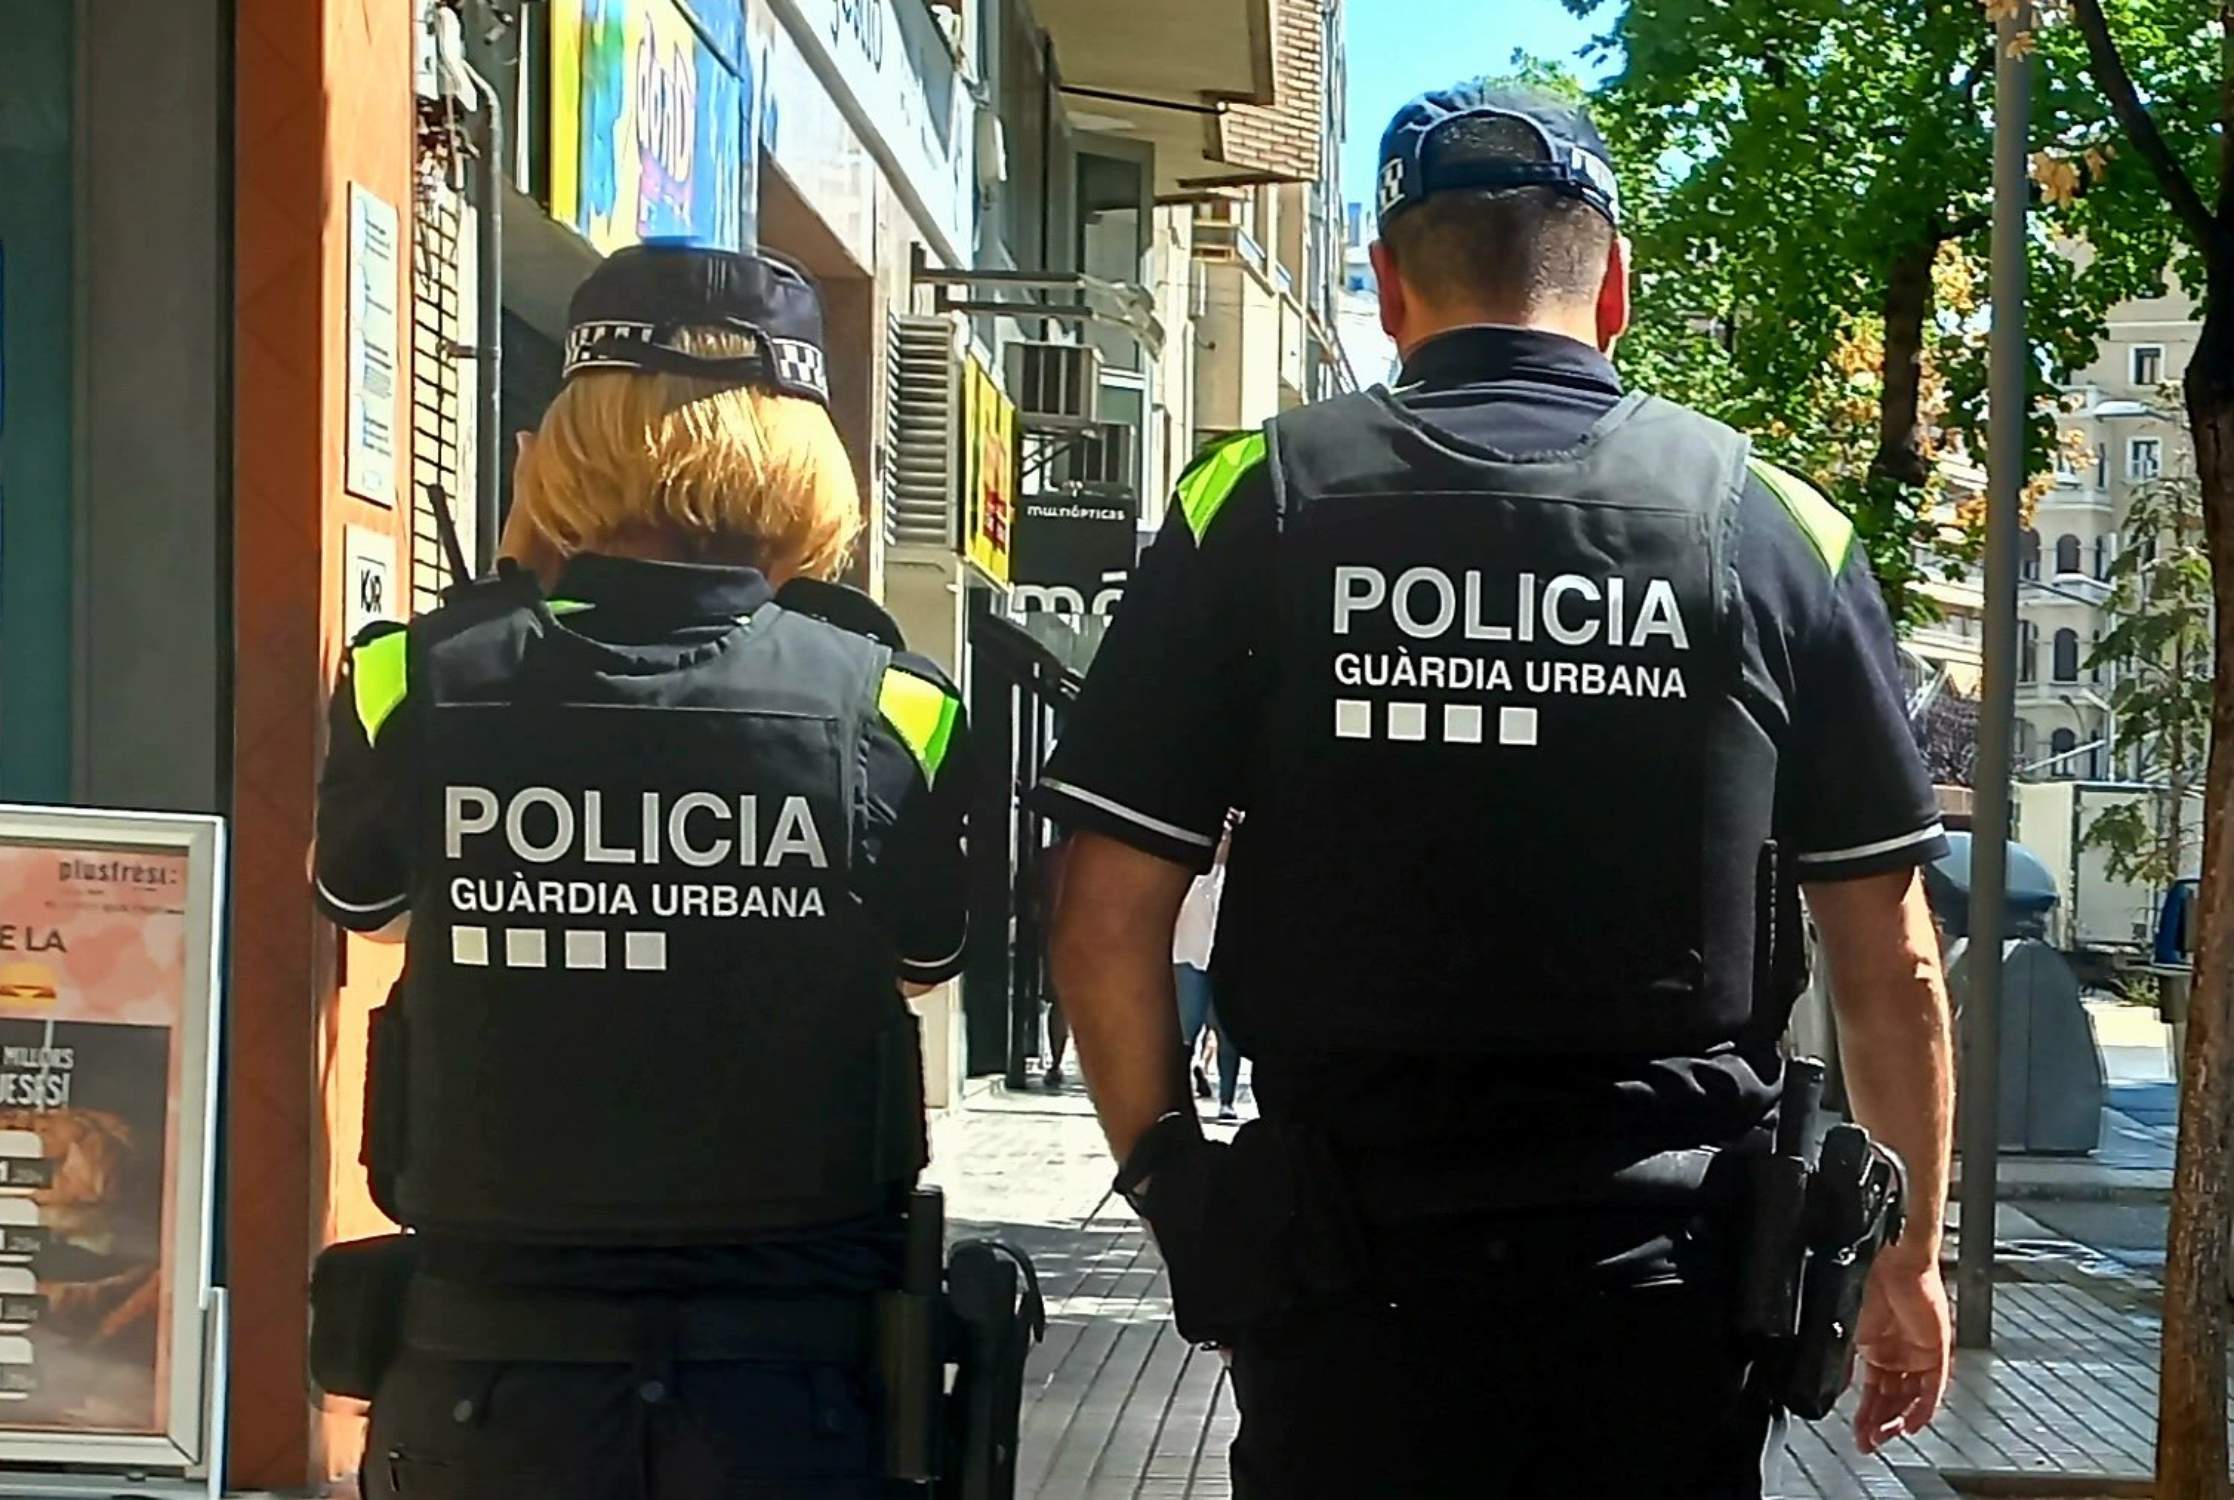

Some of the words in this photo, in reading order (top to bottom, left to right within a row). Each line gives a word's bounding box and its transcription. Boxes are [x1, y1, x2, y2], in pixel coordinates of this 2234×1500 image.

[1333, 566, 1690, 650] POLICIA
[1334, 645, 1513, 692] GUÀRDIA
[1525, 660, 1688, 698] URBANA
[445, 785, 829, 869] POLICIA
[450, 871, 638, 916] GUÀRDIA
[651, 883, 827, 918] URBANA
[25, 926, 68, 954] LA
